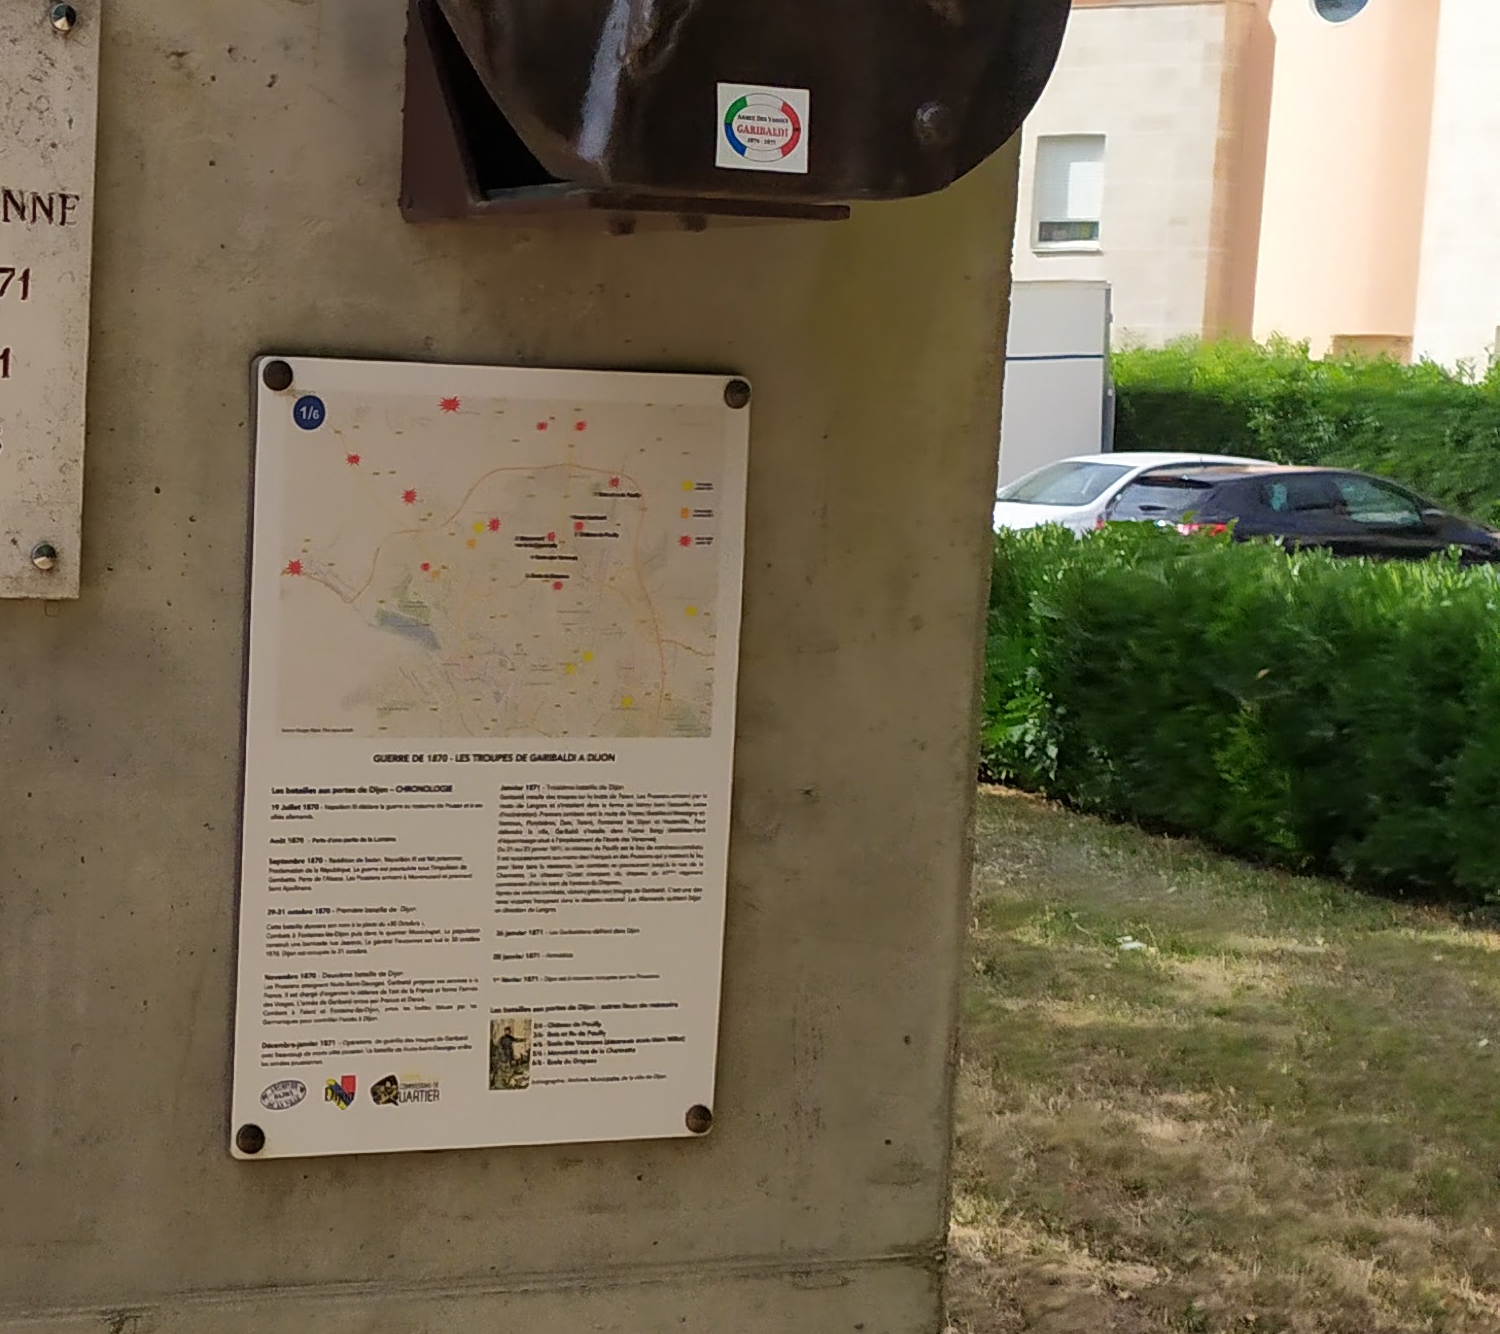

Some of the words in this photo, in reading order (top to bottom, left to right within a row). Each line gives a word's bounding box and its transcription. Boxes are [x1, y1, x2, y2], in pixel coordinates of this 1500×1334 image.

[737, 124, 788, 137] GARIBALDI
[299, 406, 320, 420] 1/6
[373, 754, 409, 762] GUERRE
[412, 754, 424, 762] DE
[427, 754, 448, 762] 1870
[455, 754, 470, 762] LES
[472, 754, 513, 762] TROUPES
[515, 754, 527, 762] DE
[530, 754, 577, 762] GARIBALDI
[587, 754, 615, 762] DIJON
[369, 785, 388, 795] Dijon
